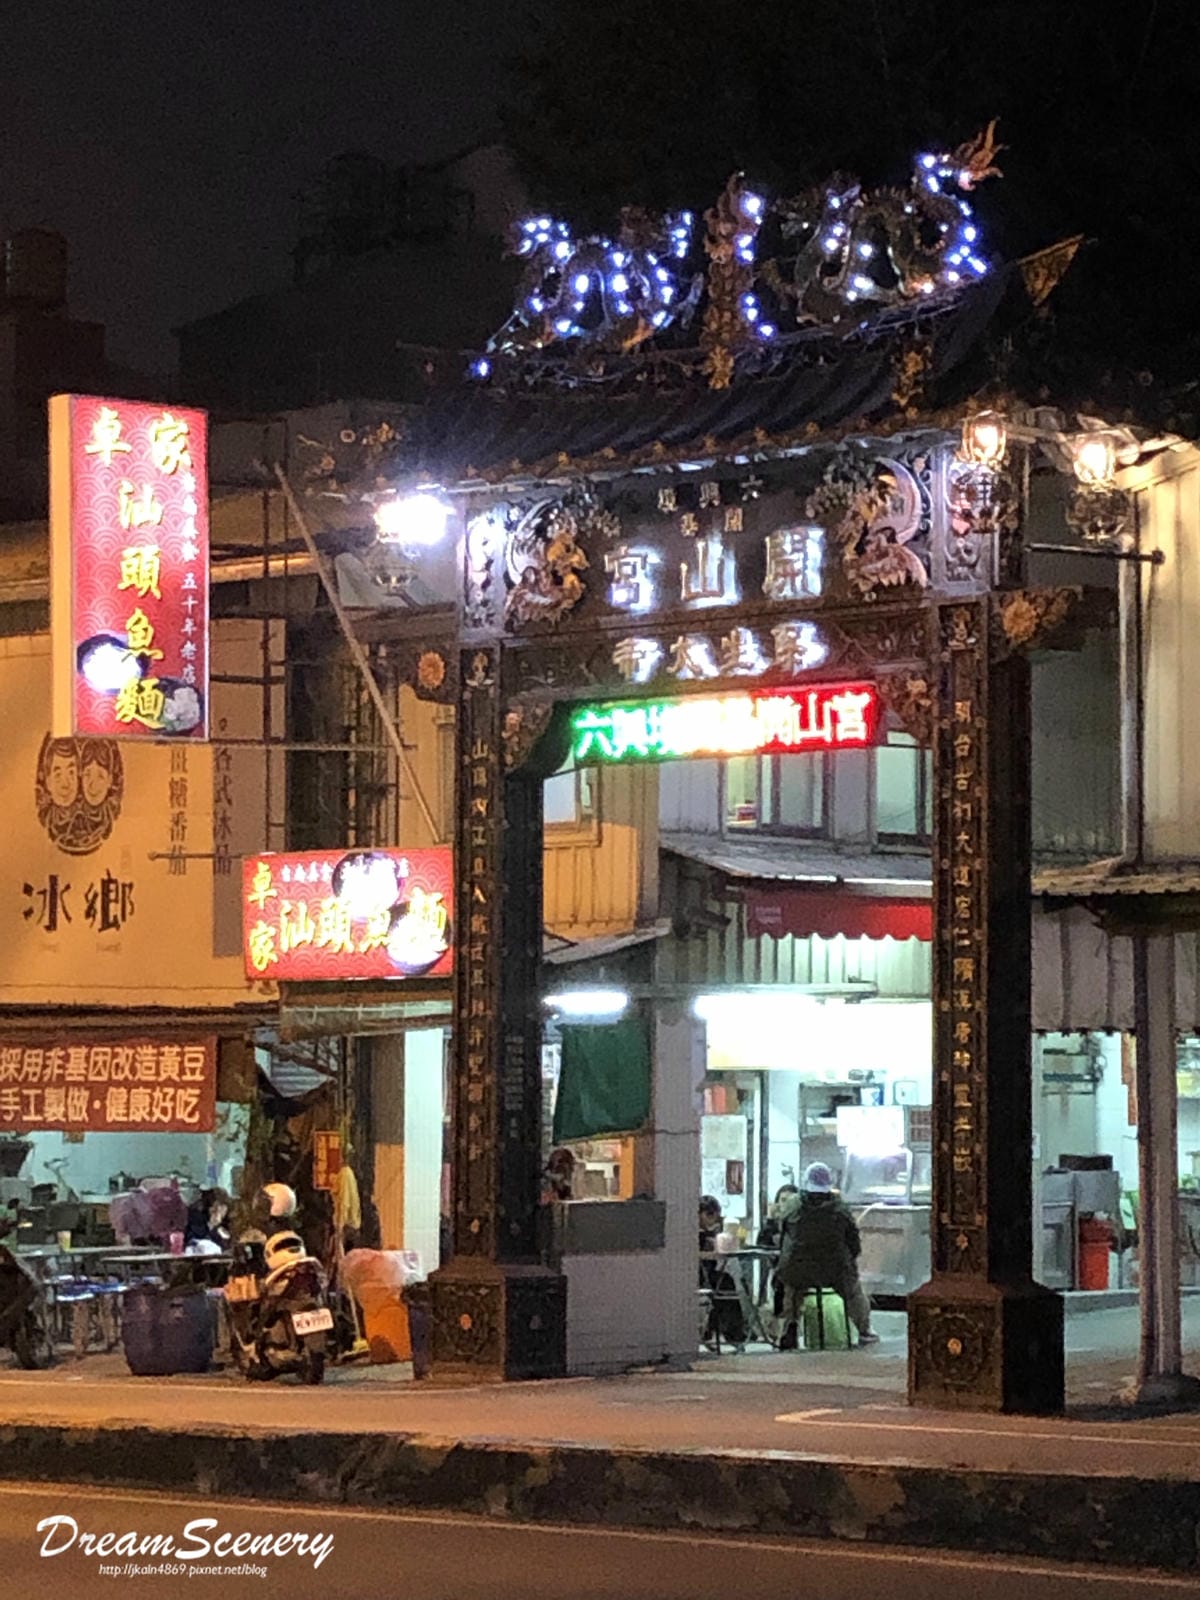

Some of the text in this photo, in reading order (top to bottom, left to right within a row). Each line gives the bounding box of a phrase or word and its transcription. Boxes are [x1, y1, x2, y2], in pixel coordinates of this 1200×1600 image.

[86, 407, 193, 475] 卓家
[114, 480, 168, 731] 汕頭魚麵
[180, 572, 198, 685] 五十年老店
[23, 868, 135, 933] 冰鄉
[248, 861, 278, 971] 卓家
[0, 1046, 206, 1082] 採用非基因改造黃豆
